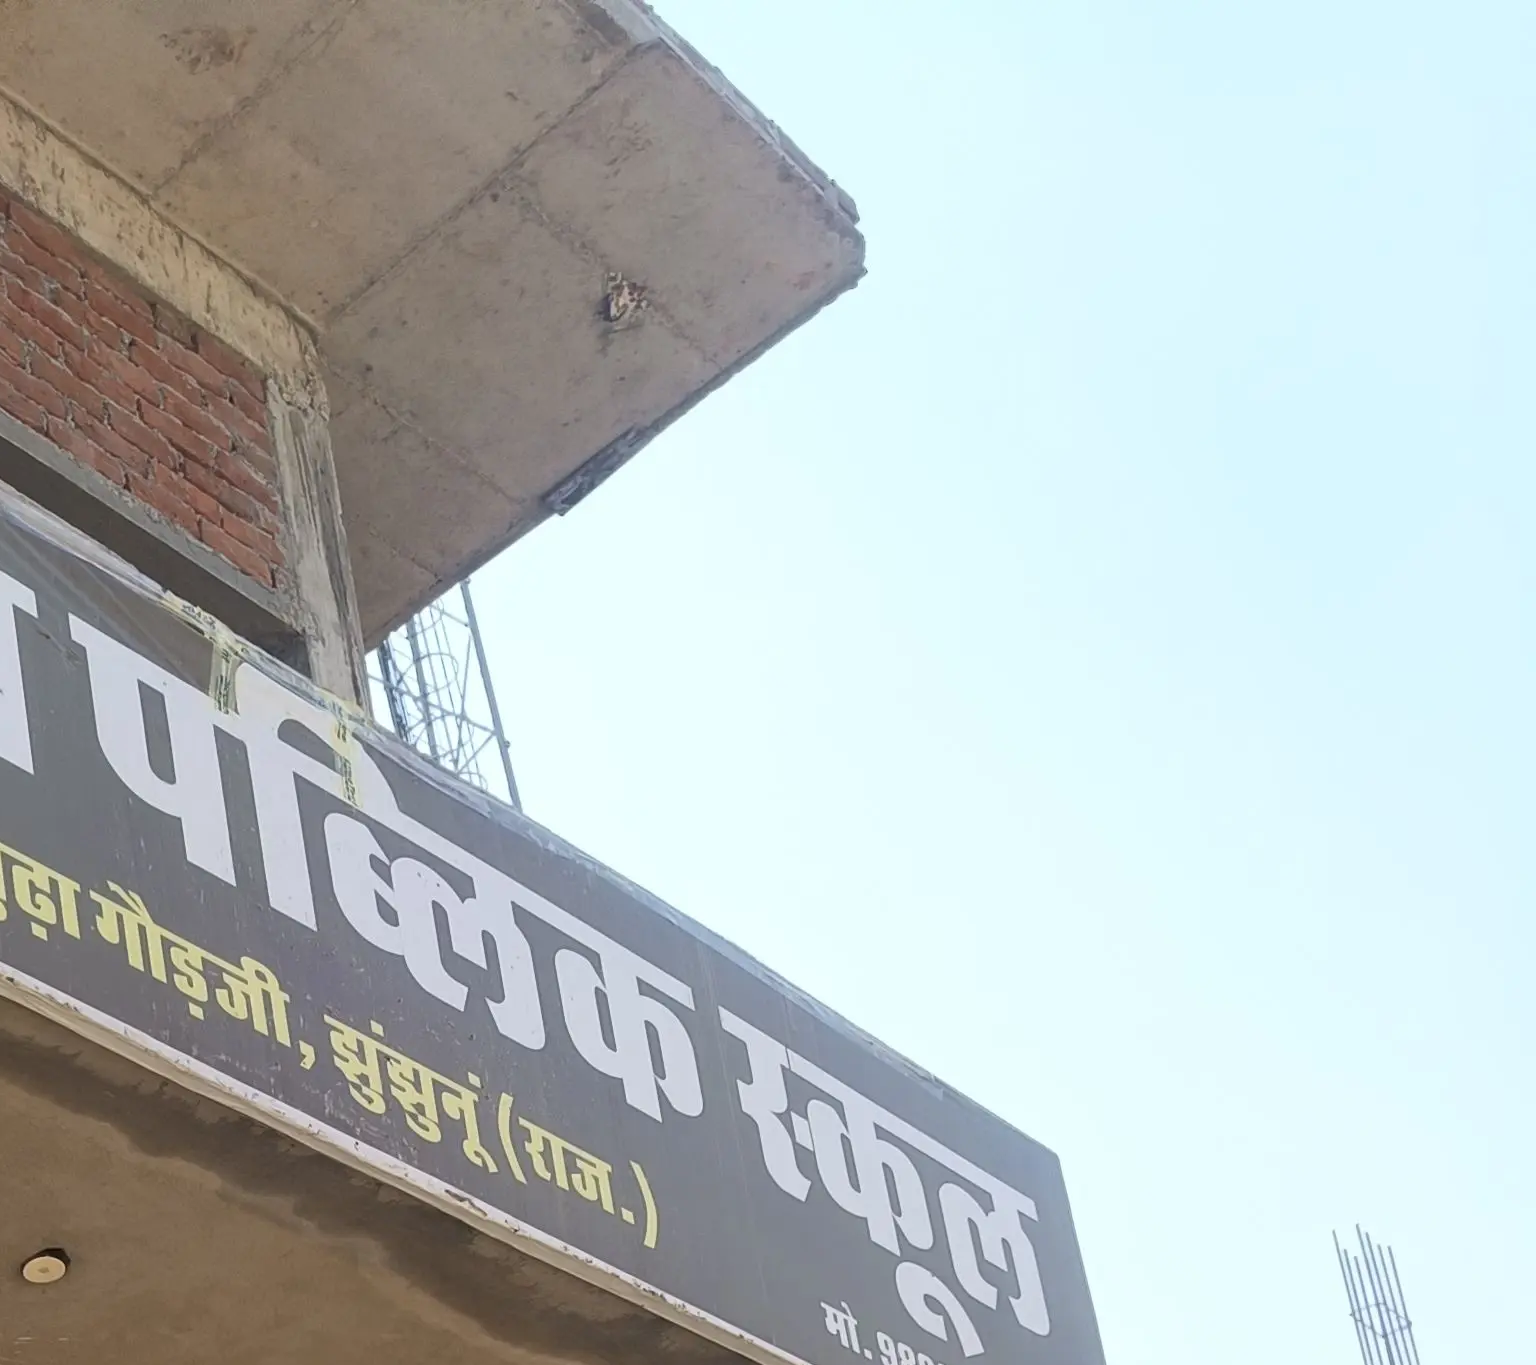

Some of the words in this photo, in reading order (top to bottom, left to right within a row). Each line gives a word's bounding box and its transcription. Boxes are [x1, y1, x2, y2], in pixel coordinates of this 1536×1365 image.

[67, 612, 705, 1122] पब्लिक
[718, 1006, 1051, 1358] स्कूल
[323, 1014, 497, 1174] झुंझुनूं
[498, 1092, 658, 1248] (राज.)
[820, 1301, 872, 1360] मो.
